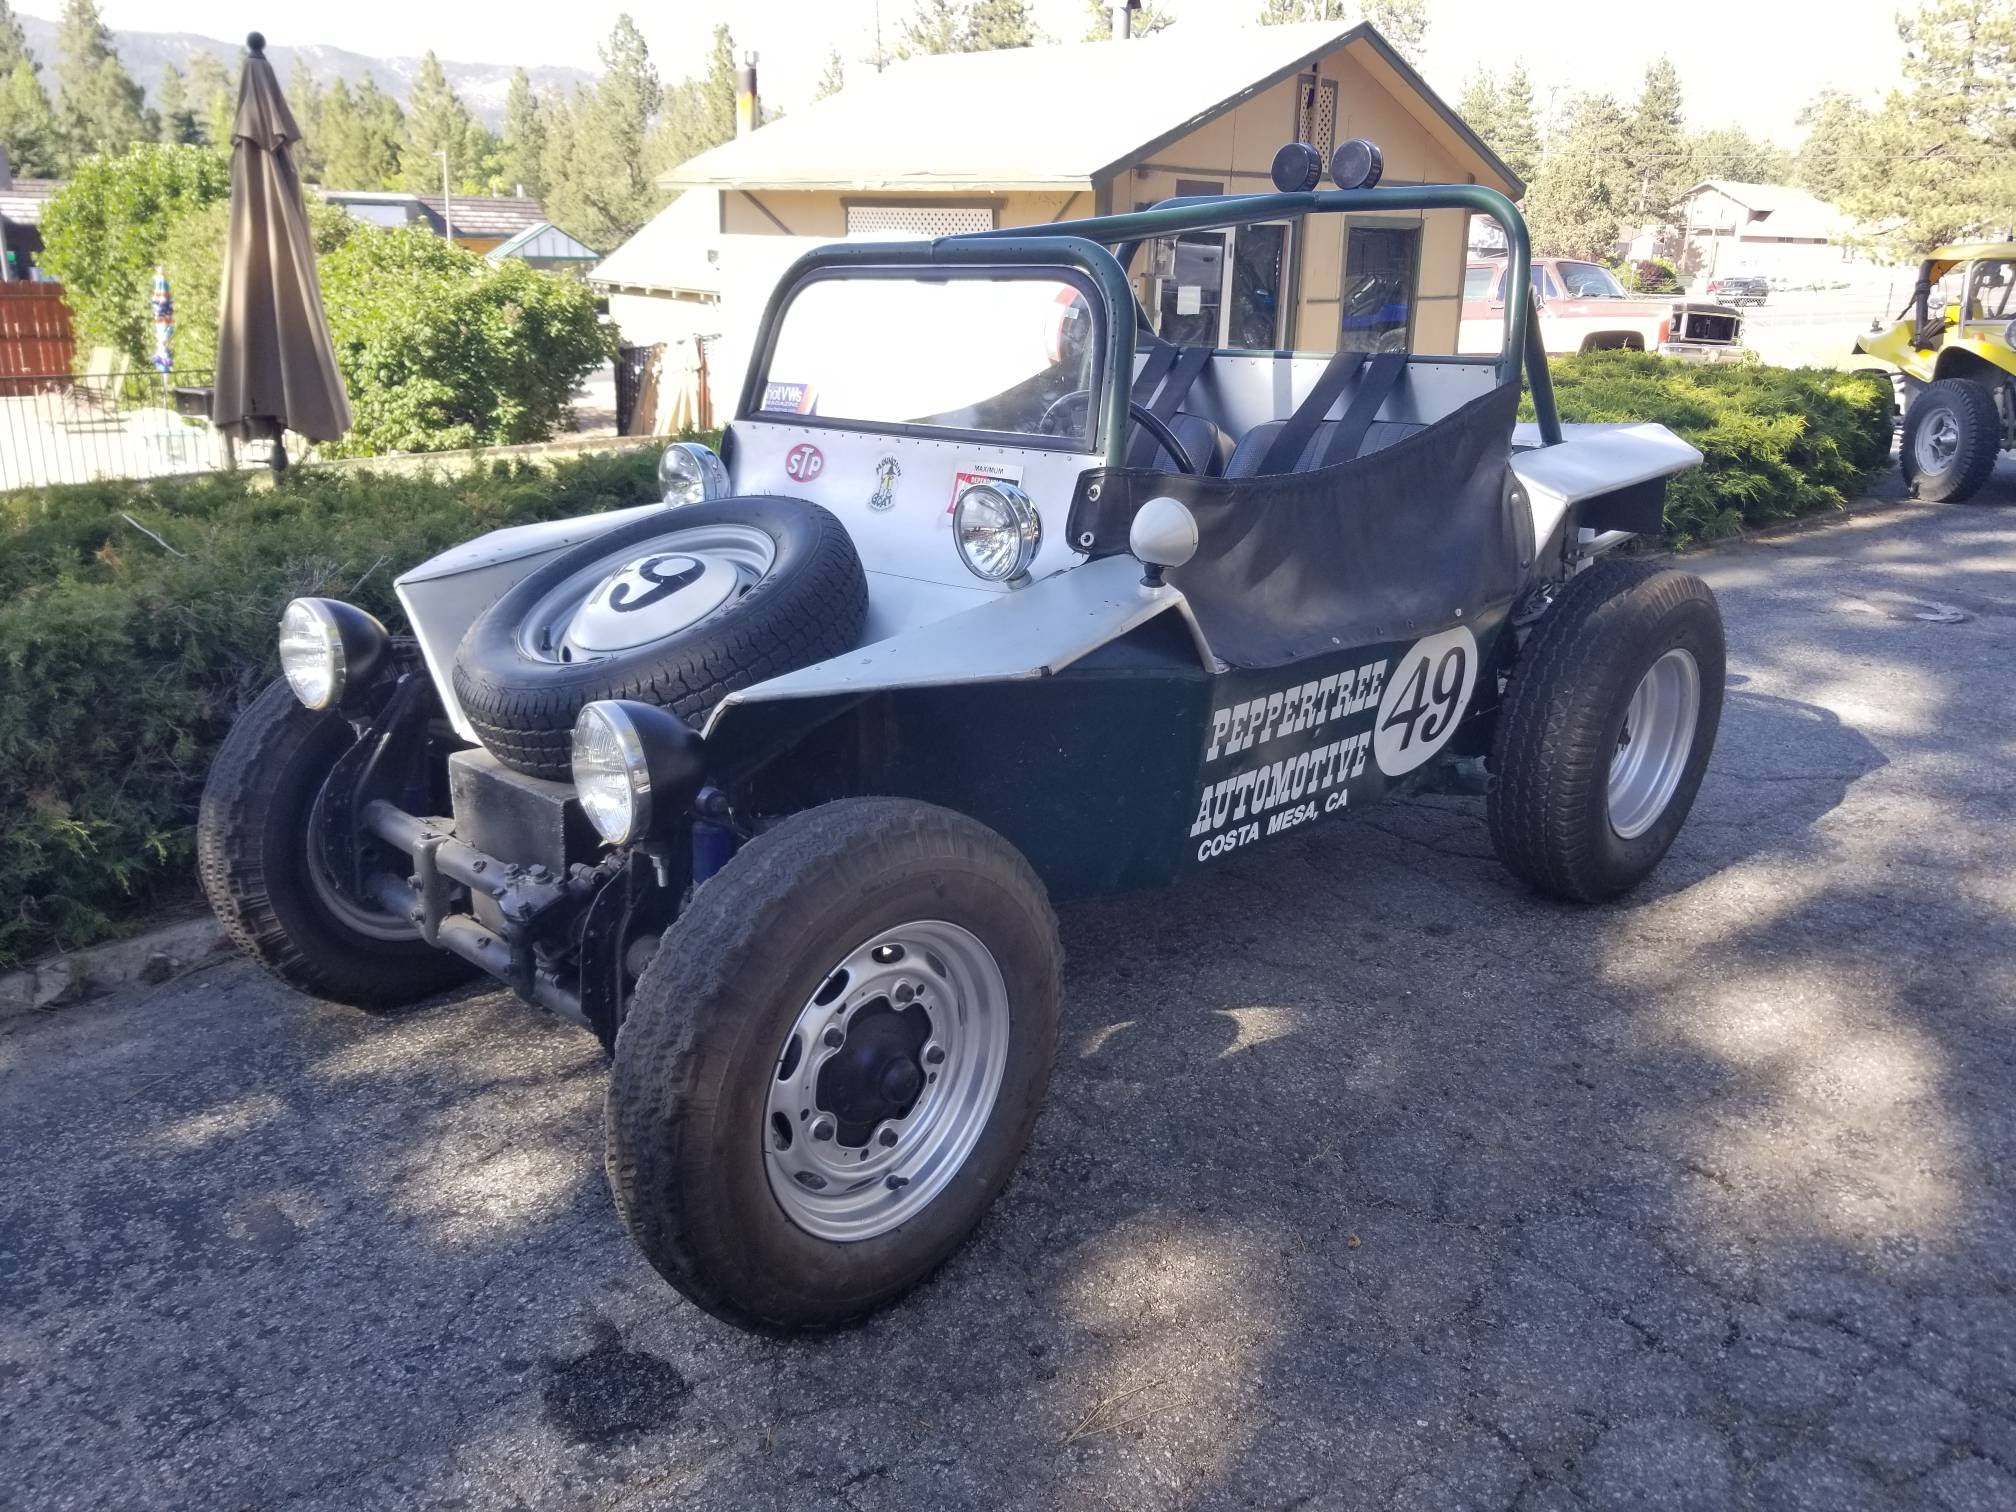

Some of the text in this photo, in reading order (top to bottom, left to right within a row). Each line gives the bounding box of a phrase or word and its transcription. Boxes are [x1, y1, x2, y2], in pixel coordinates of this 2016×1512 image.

[788, 447, 821, 478] STP
[974, 464, 1004, 475] MAXIMUM
[1206, 659, 1388, 762] PEPPERTREE
[1381, 646, 1466, 752] 49
[1190, 731, 1371, 837] AUTOMOTIVE
[1197, 789, 1348, 862] COSTA MESA, CA
